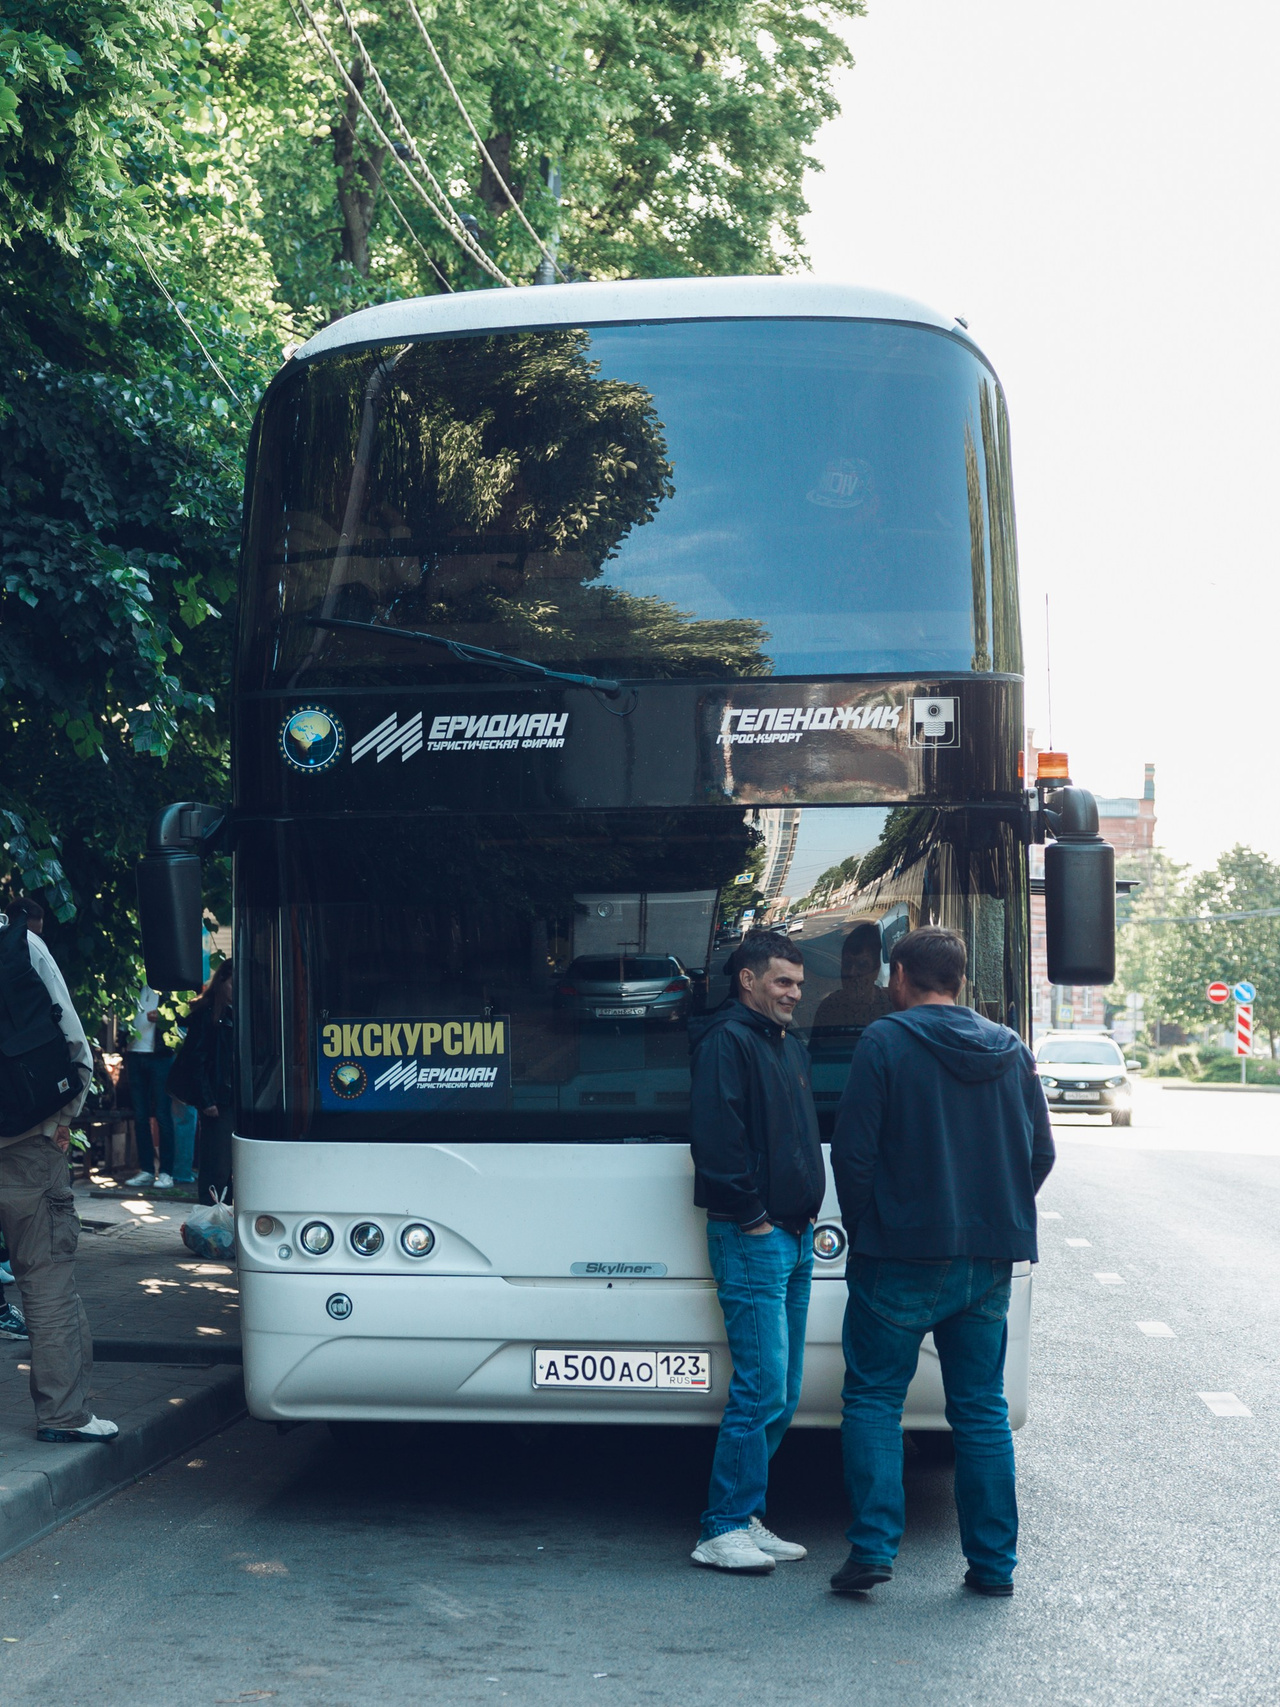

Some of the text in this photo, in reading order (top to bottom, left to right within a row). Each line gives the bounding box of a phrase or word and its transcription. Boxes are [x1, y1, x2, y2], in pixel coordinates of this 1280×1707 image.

[720, 705, 903, 732] ГЕЛЕНДЖИК
[427, 737, 565, 752] ТУРИСТИЧЕСКАЯ ФИРМА
[716, 732, 803, 745] ГОРОД-КУРОРТ
[322, 1021, 505, 1058] ЭКСКУРСИИ
[416, 1081, 468, 1089] ТУРИСТИЧЕСКАЯ
[585, 1262, 653, 1275] Skyliner
[544, 1354, 701, 1383] А500АО 123
[669, 1376, 691, 1385] RUS
